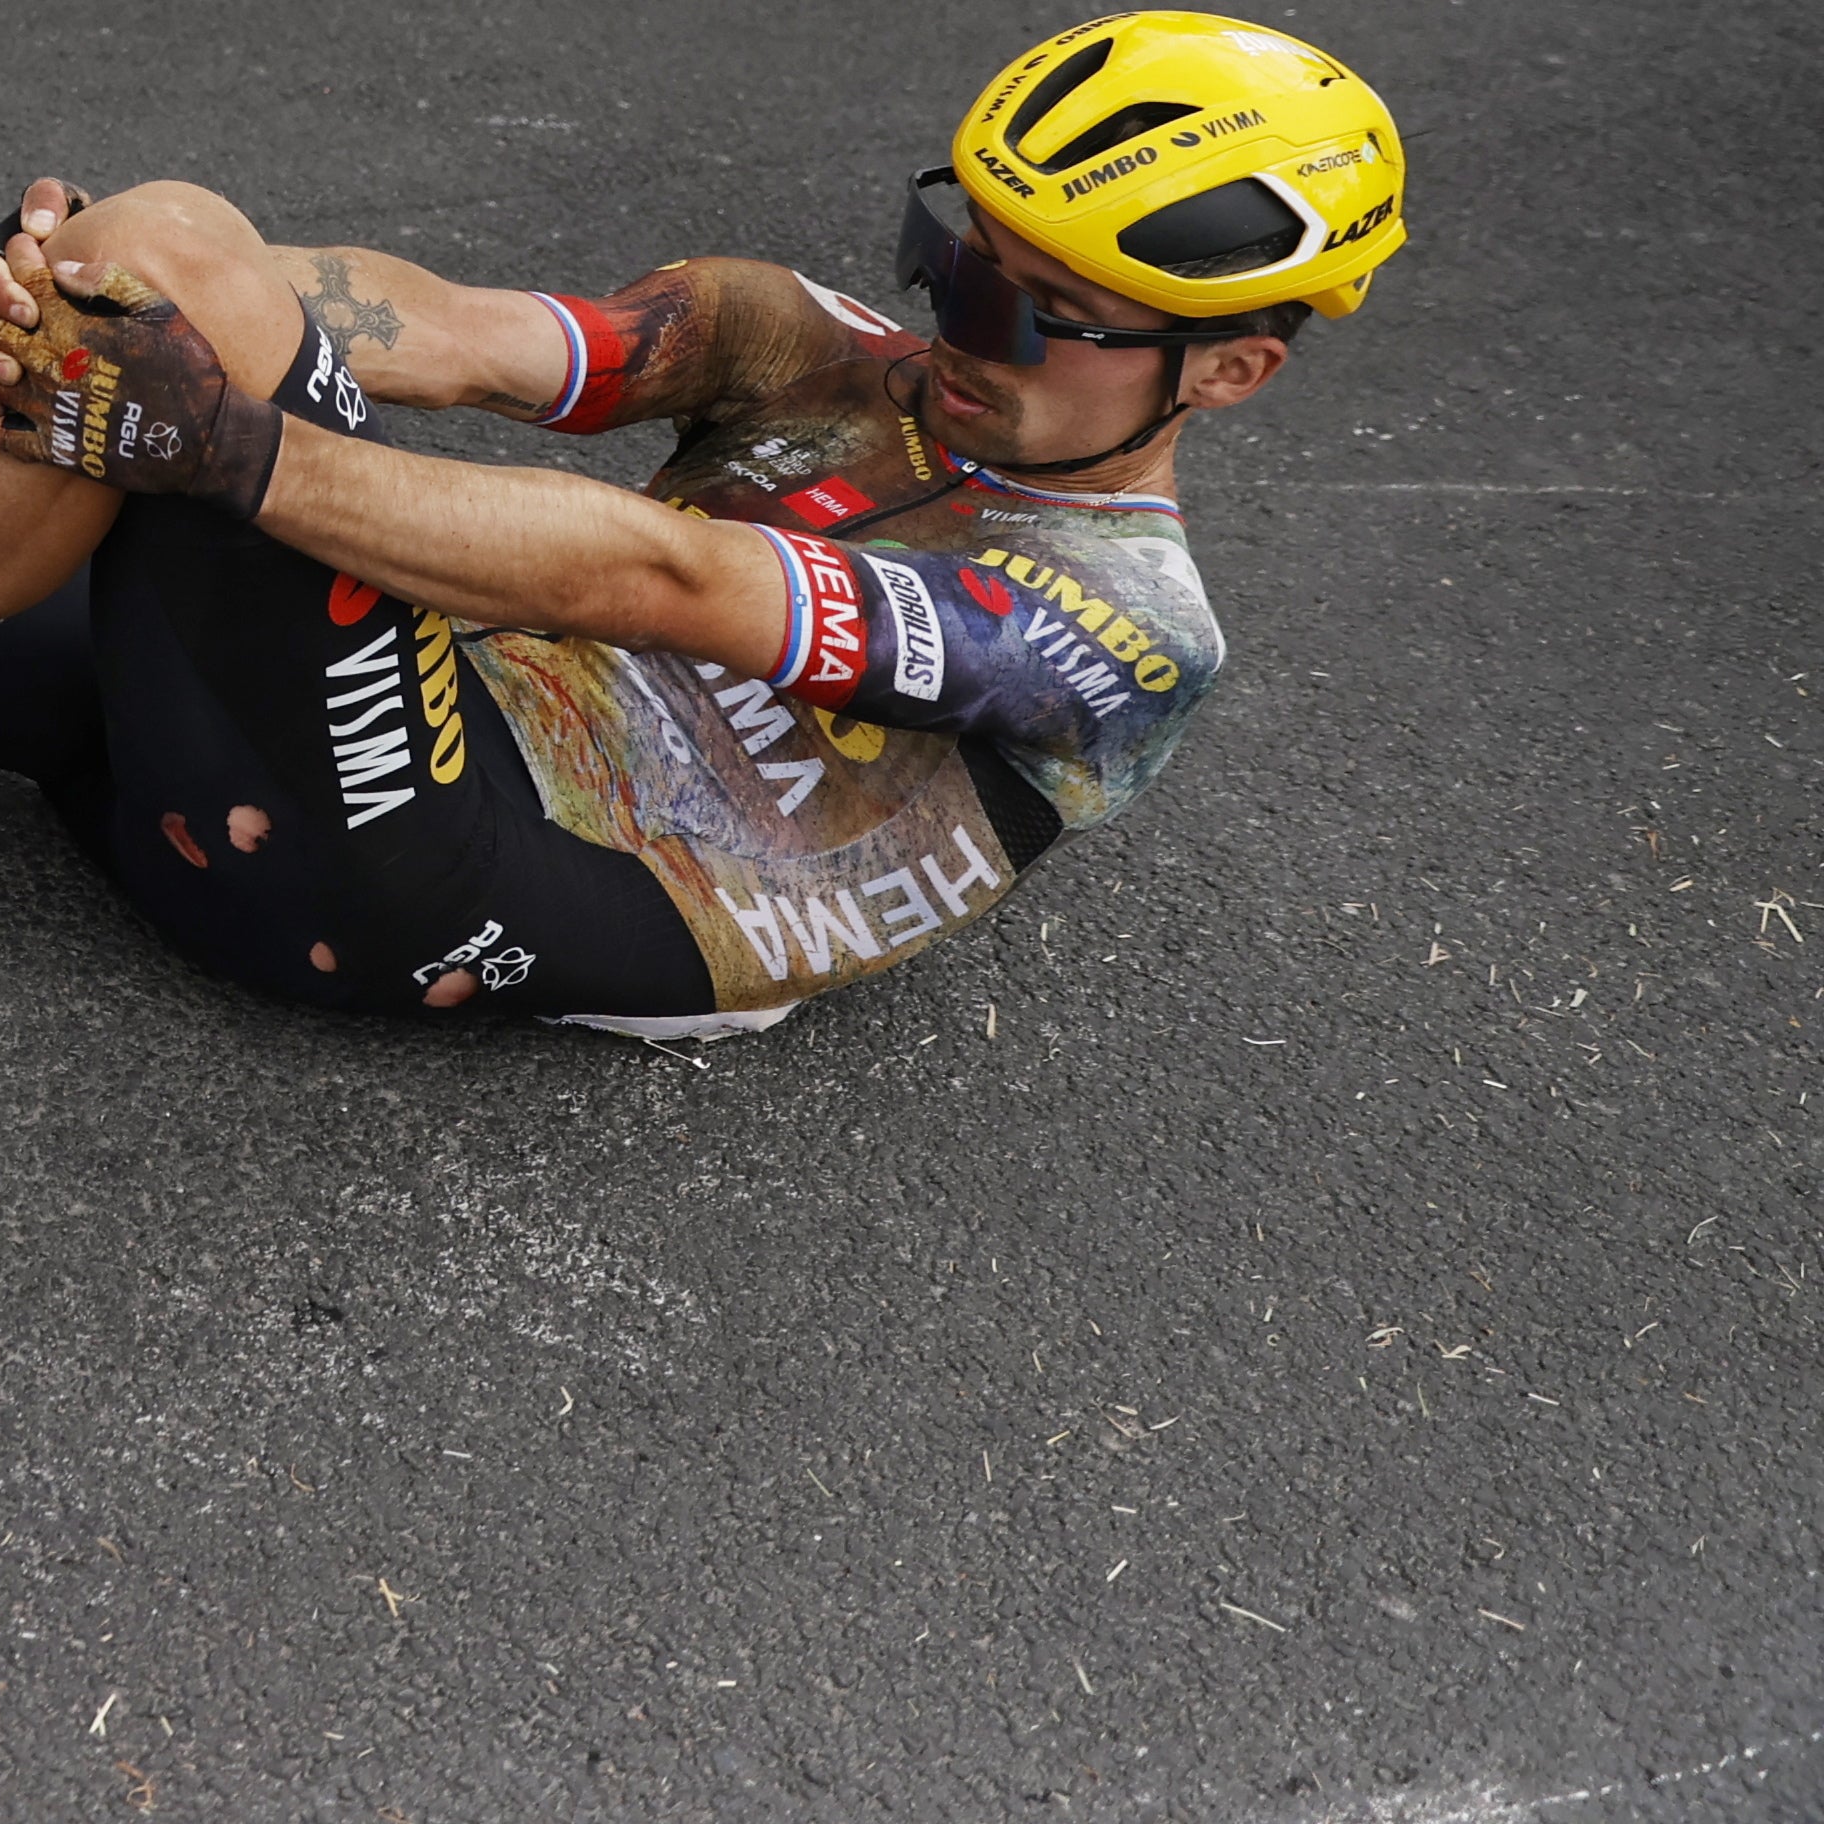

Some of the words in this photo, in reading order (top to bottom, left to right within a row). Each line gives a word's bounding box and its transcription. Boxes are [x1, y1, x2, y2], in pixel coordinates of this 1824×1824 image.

[982, 74, 1026, 123] VISMA
[974, 147, 1036, 200] LAZER
[1062, 145, 1158, 203] JUMBO
[1201, 108, 1268, 139] VISMA
[1321, 194, 1395, 253] LAZER
[52, 390, 81, 467] VISMA
[80, 356, 122, 478] JUMBO
[118, 401, 143, 459] AGU
[898, 415, 933, 481] JUMBO
[804, 487, 849, 518] HEMA
[980, 508, 1038, 524] VISMA
[795, 533, 862, 684] HEMA
[888, 562, 934, 685] GORILLAS
[969, 547, 1181, 695] JUMBO
[1021, 607, 1130, 719] VISMA
[326, 625, 416, 830] VISMA
[713, 824, 1014, 981] HEMA
